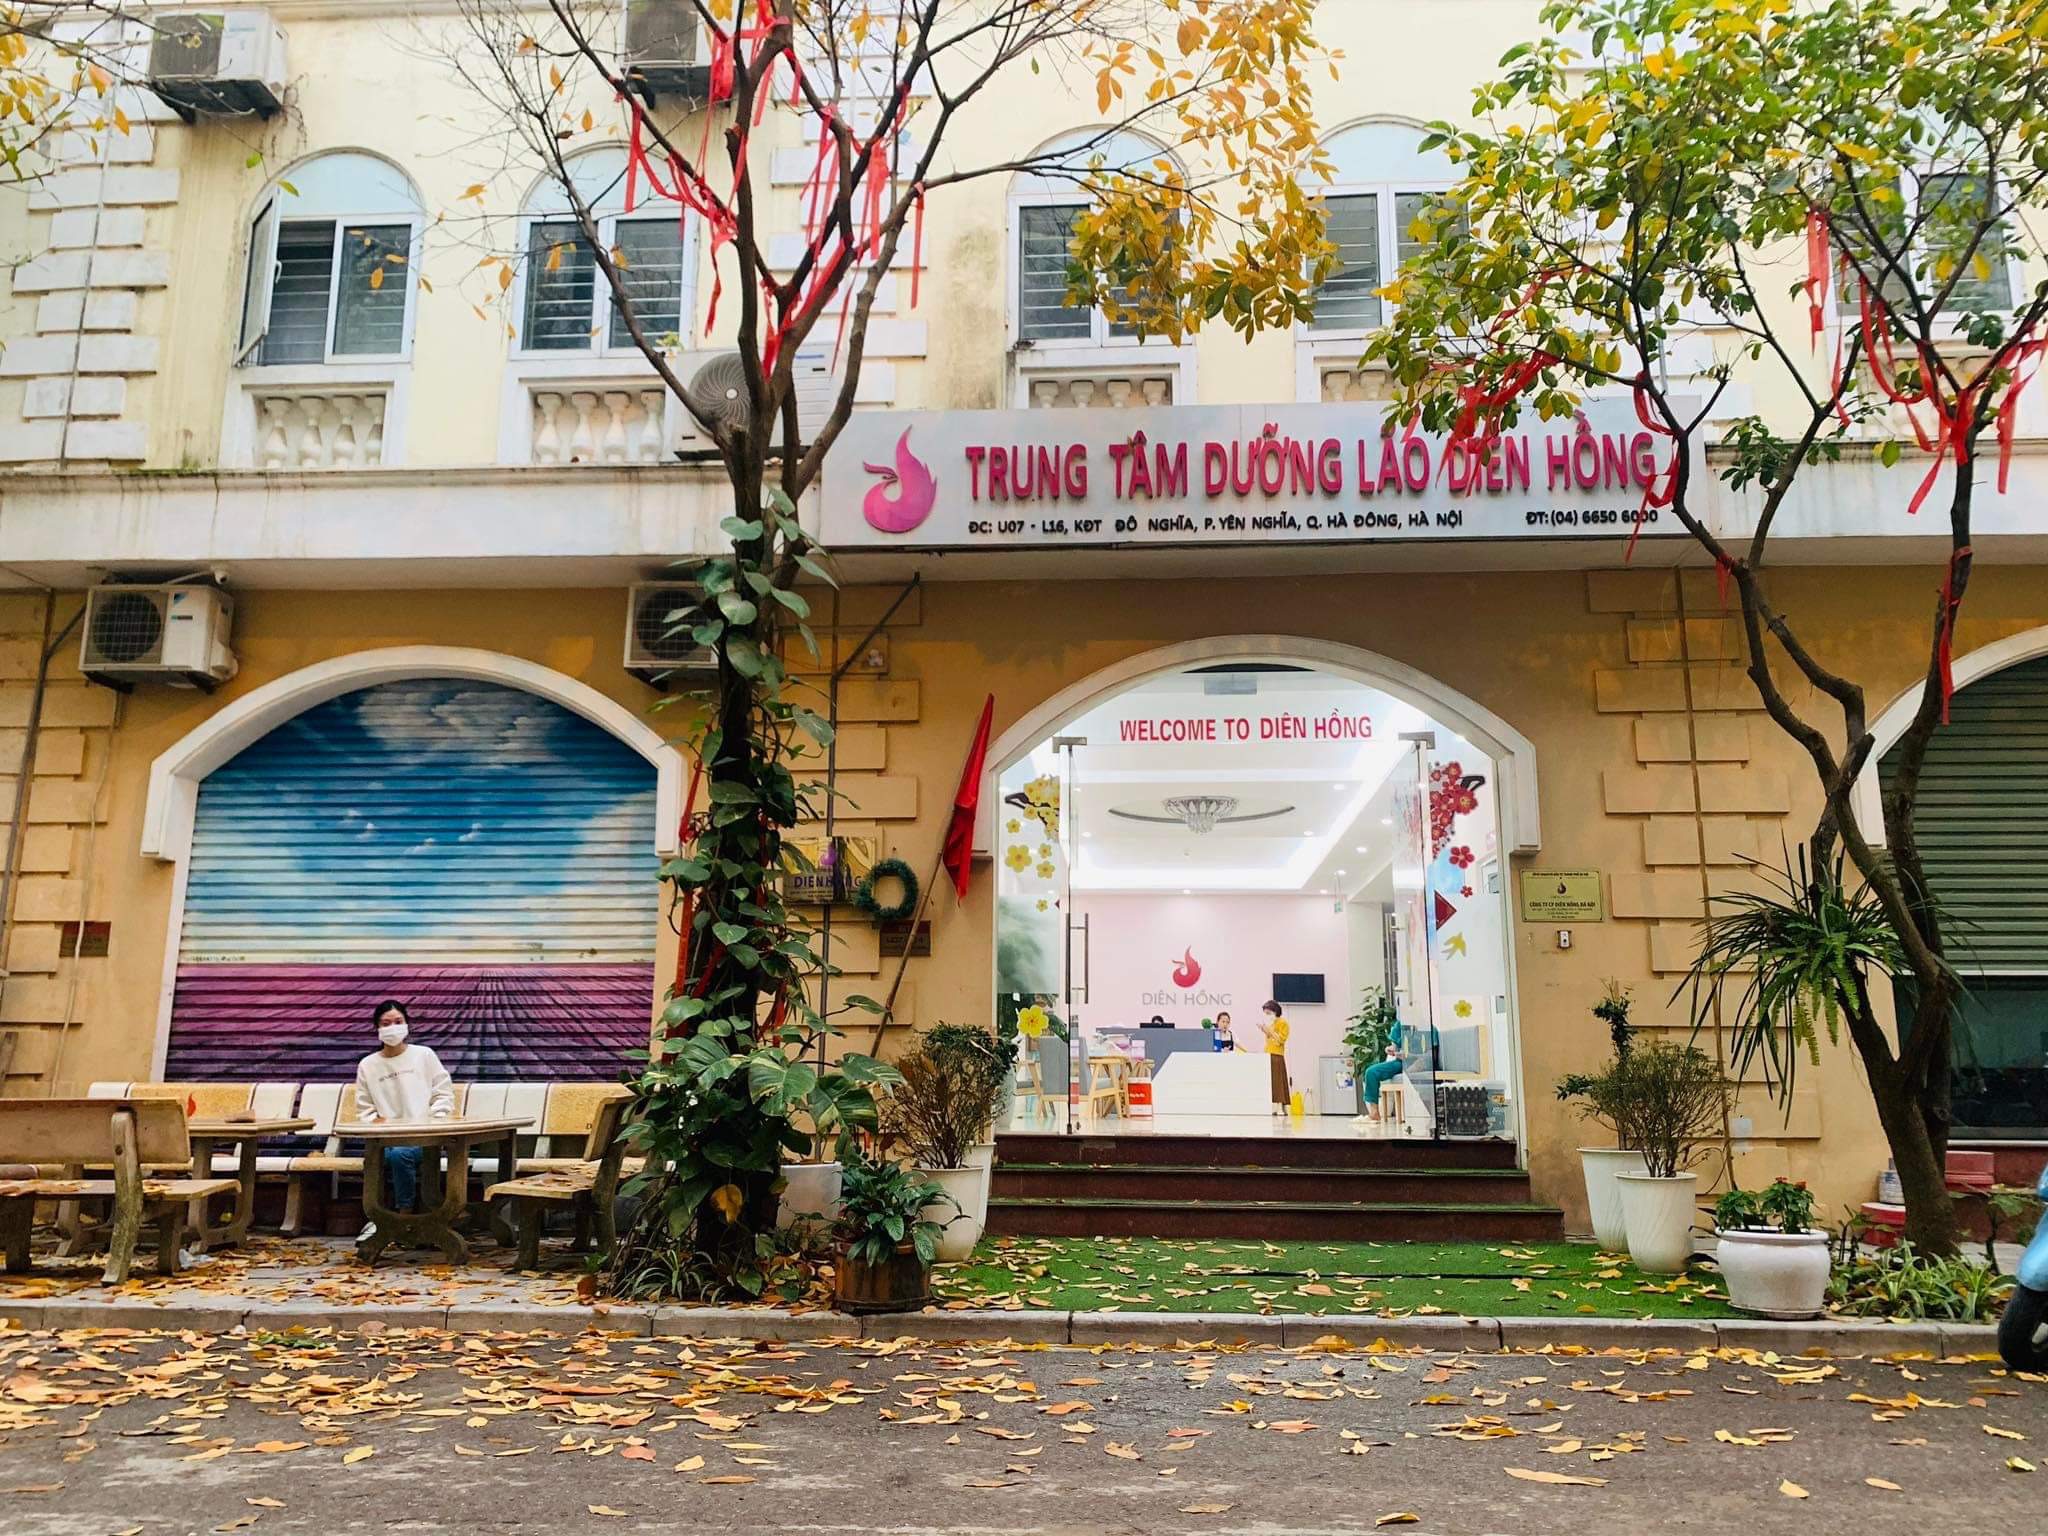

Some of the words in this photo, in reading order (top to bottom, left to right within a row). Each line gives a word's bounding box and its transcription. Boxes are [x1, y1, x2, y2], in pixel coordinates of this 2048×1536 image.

[965, 444, 1088, 500] TRUNG
[1108, 429, 1189, 500] TÂM
[1204, 422, 1342, 497] DƯỠNG
[1546, 408, 1656, 492] HỒNG
[968, 521, 993, 534] ĐC:
[998, 520, 1025, 534] U07
[1042, 519, 1068, 535] L16,
[1074, 518, 1102, 533] KĐT
[1115, 515, 1138, 532] ĐÔ
[1148, 515, 1198, 532] NGHĨA,
[1219, 514, 1246, 530] YÊN
[1252, 511, 1301, 531] NGHĨA,
[1307, 515, 1323, 530] Q.
[1327, 511, 1348, 529] HÀ
[1353, 513, 1402, 530] ĐÔNG,
[1408, 510, 1429, 527] HÀ
[1436, 510, 1463, 529] NỘI
[1582, 510, 1617, 524] 6650
[1120, 719, 1216, 741] WELCOME
[1224, 718, 1250, 740] TO
[1260, 712, 1307, 739] DIÊN
[1314, 708, 1372, 739] HỒNG
[1141, 990, 1177, 1006] DIÊN
